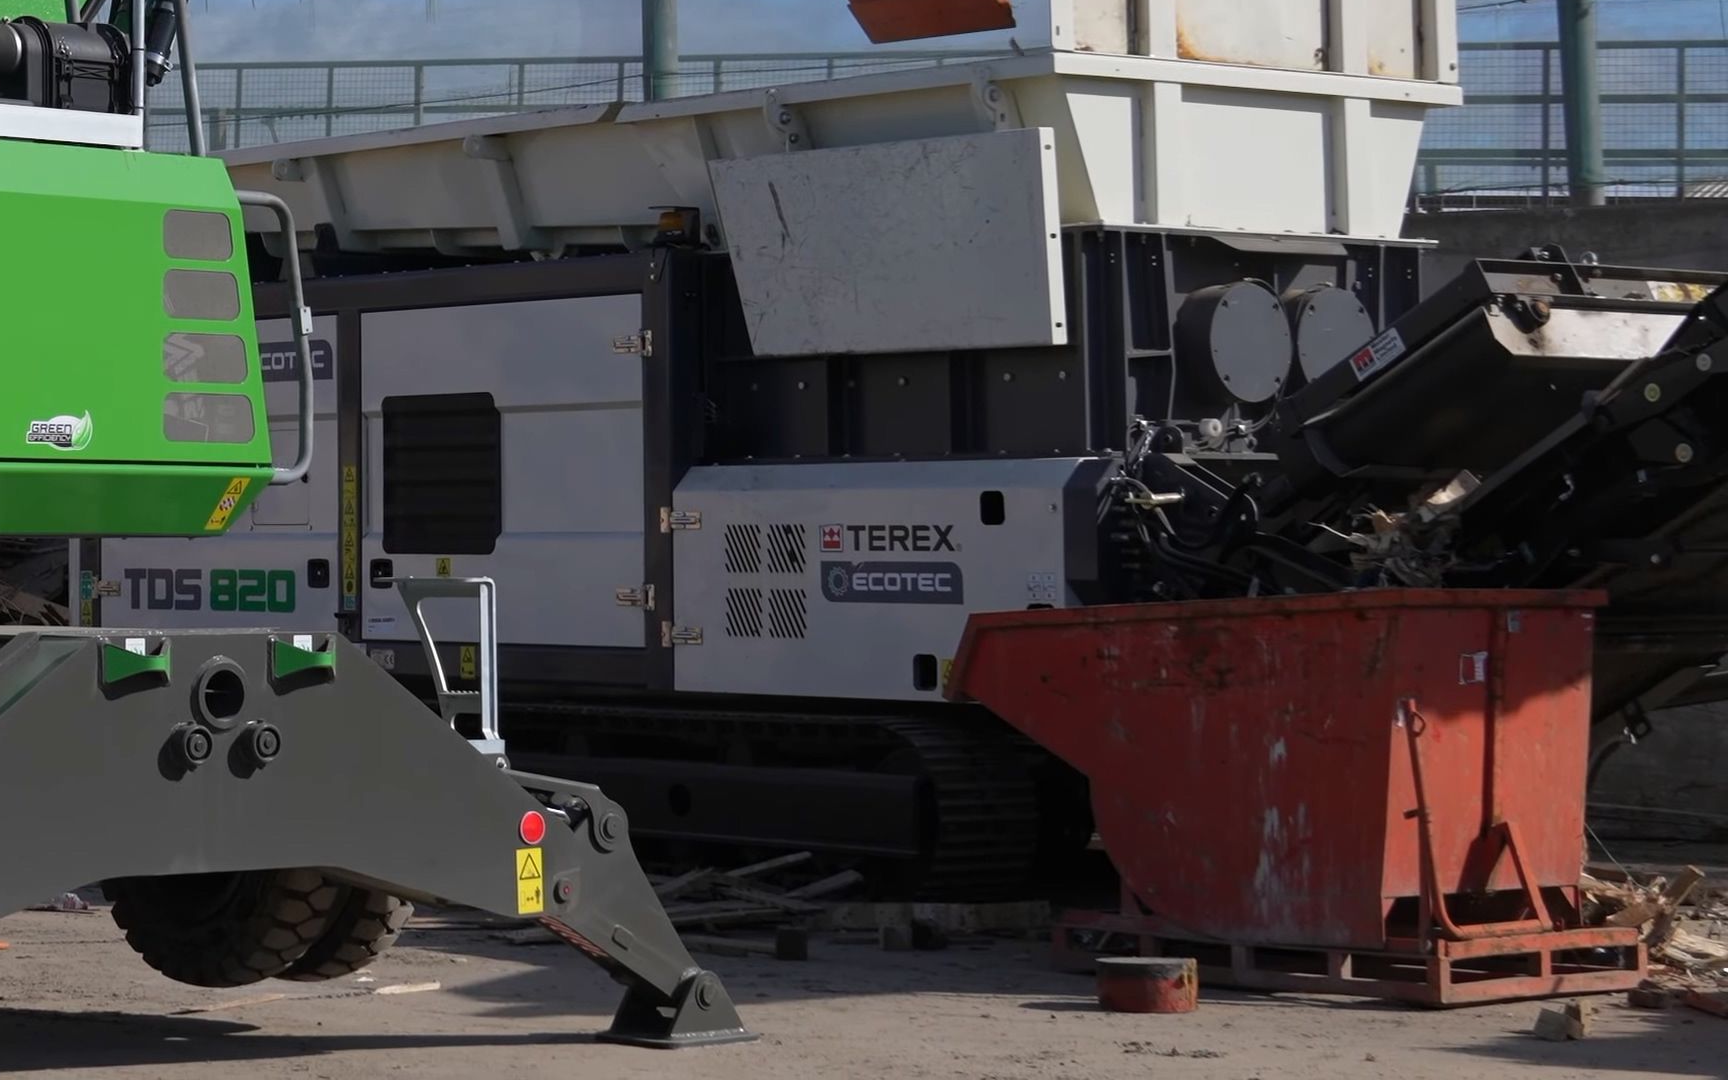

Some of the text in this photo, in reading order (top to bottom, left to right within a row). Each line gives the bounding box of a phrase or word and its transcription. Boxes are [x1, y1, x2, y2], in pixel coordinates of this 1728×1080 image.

[261, 352, 325, 371] COTC
[32, 423, 72, 434] GREEN
[124, 568, 295, 613] TDS 820
[852, 572, 952, 591] ECOTEC
